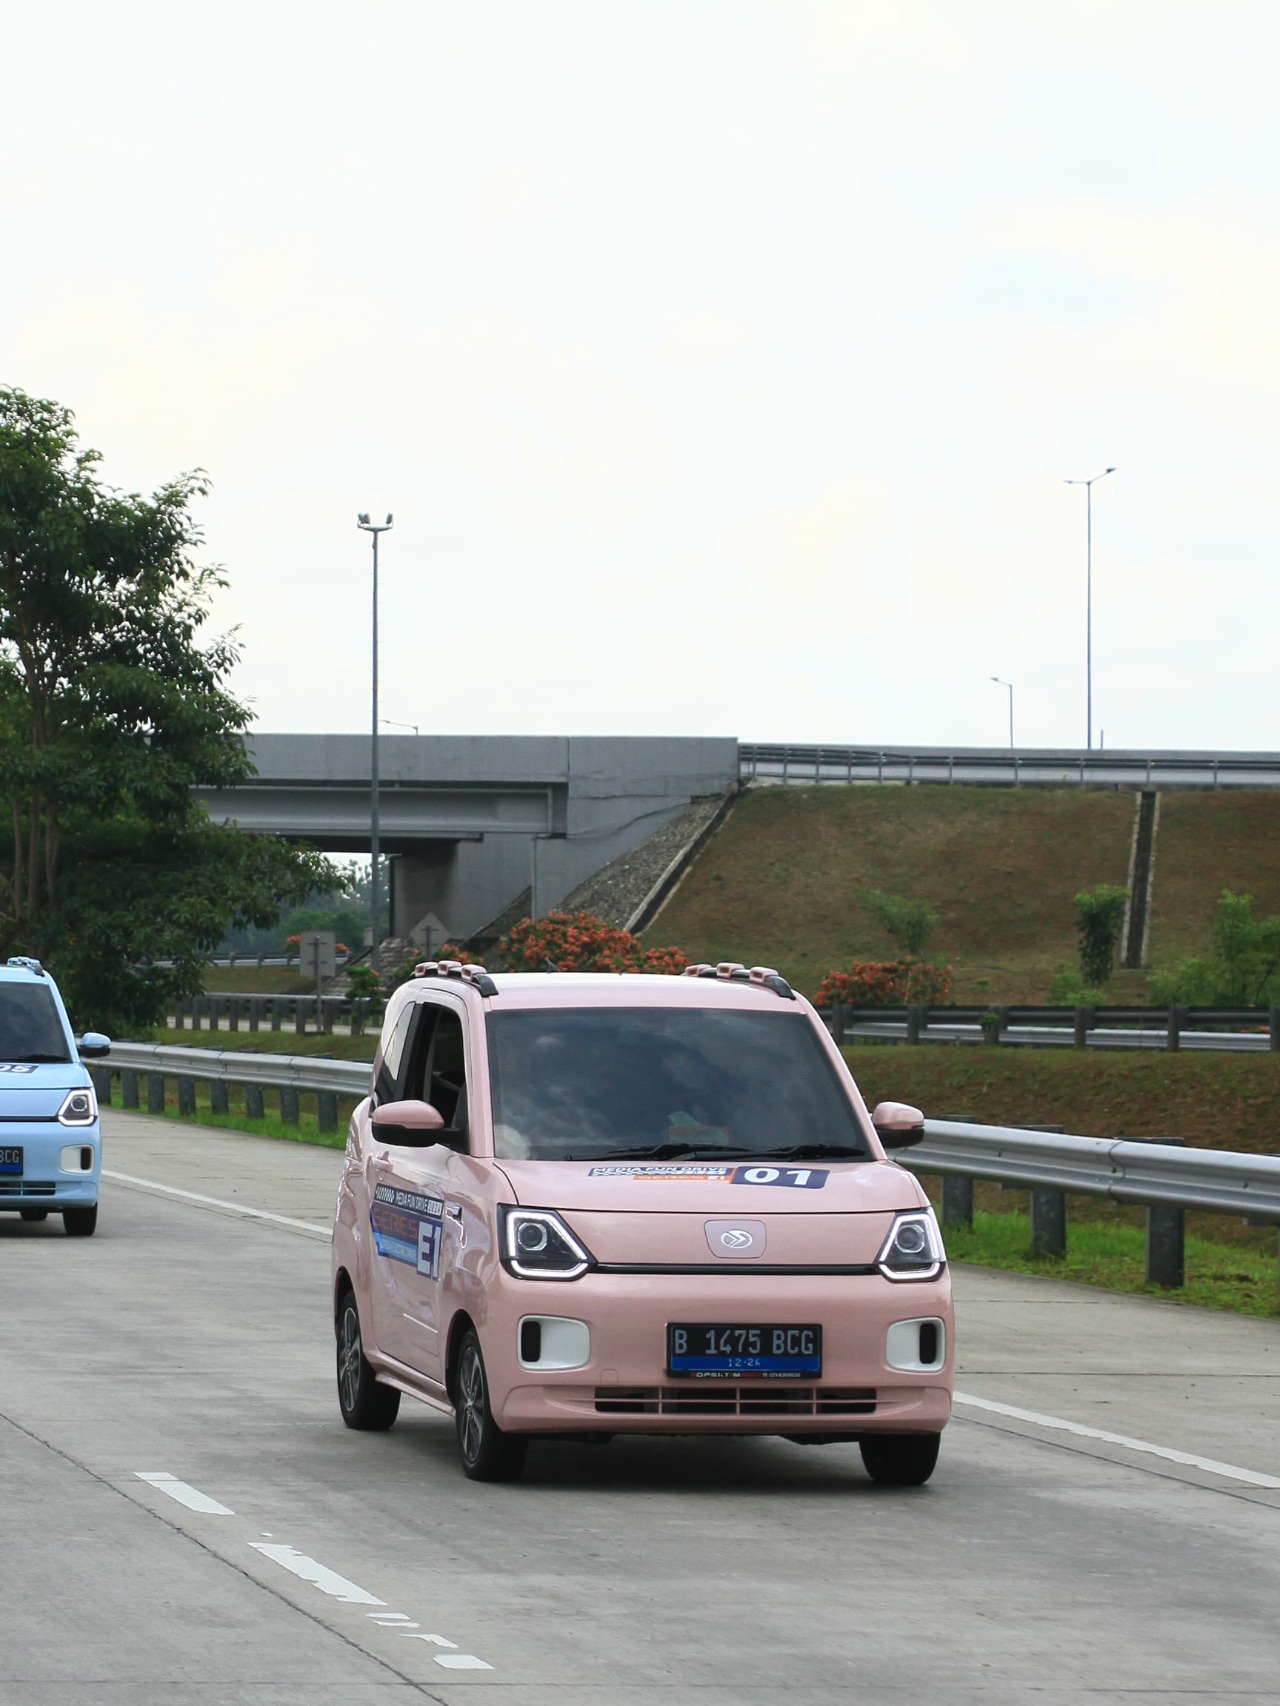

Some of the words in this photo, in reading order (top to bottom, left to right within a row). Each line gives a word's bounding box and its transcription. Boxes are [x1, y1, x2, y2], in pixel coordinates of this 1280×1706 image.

[743, 1167, 813, 1186] 01
[417, 1221, 441, 1277] E1
[674, 1329, 688, 1354] B
[705, 1329, 761, 1355] 1475
[772, 1329, 814, 1355] BCG
